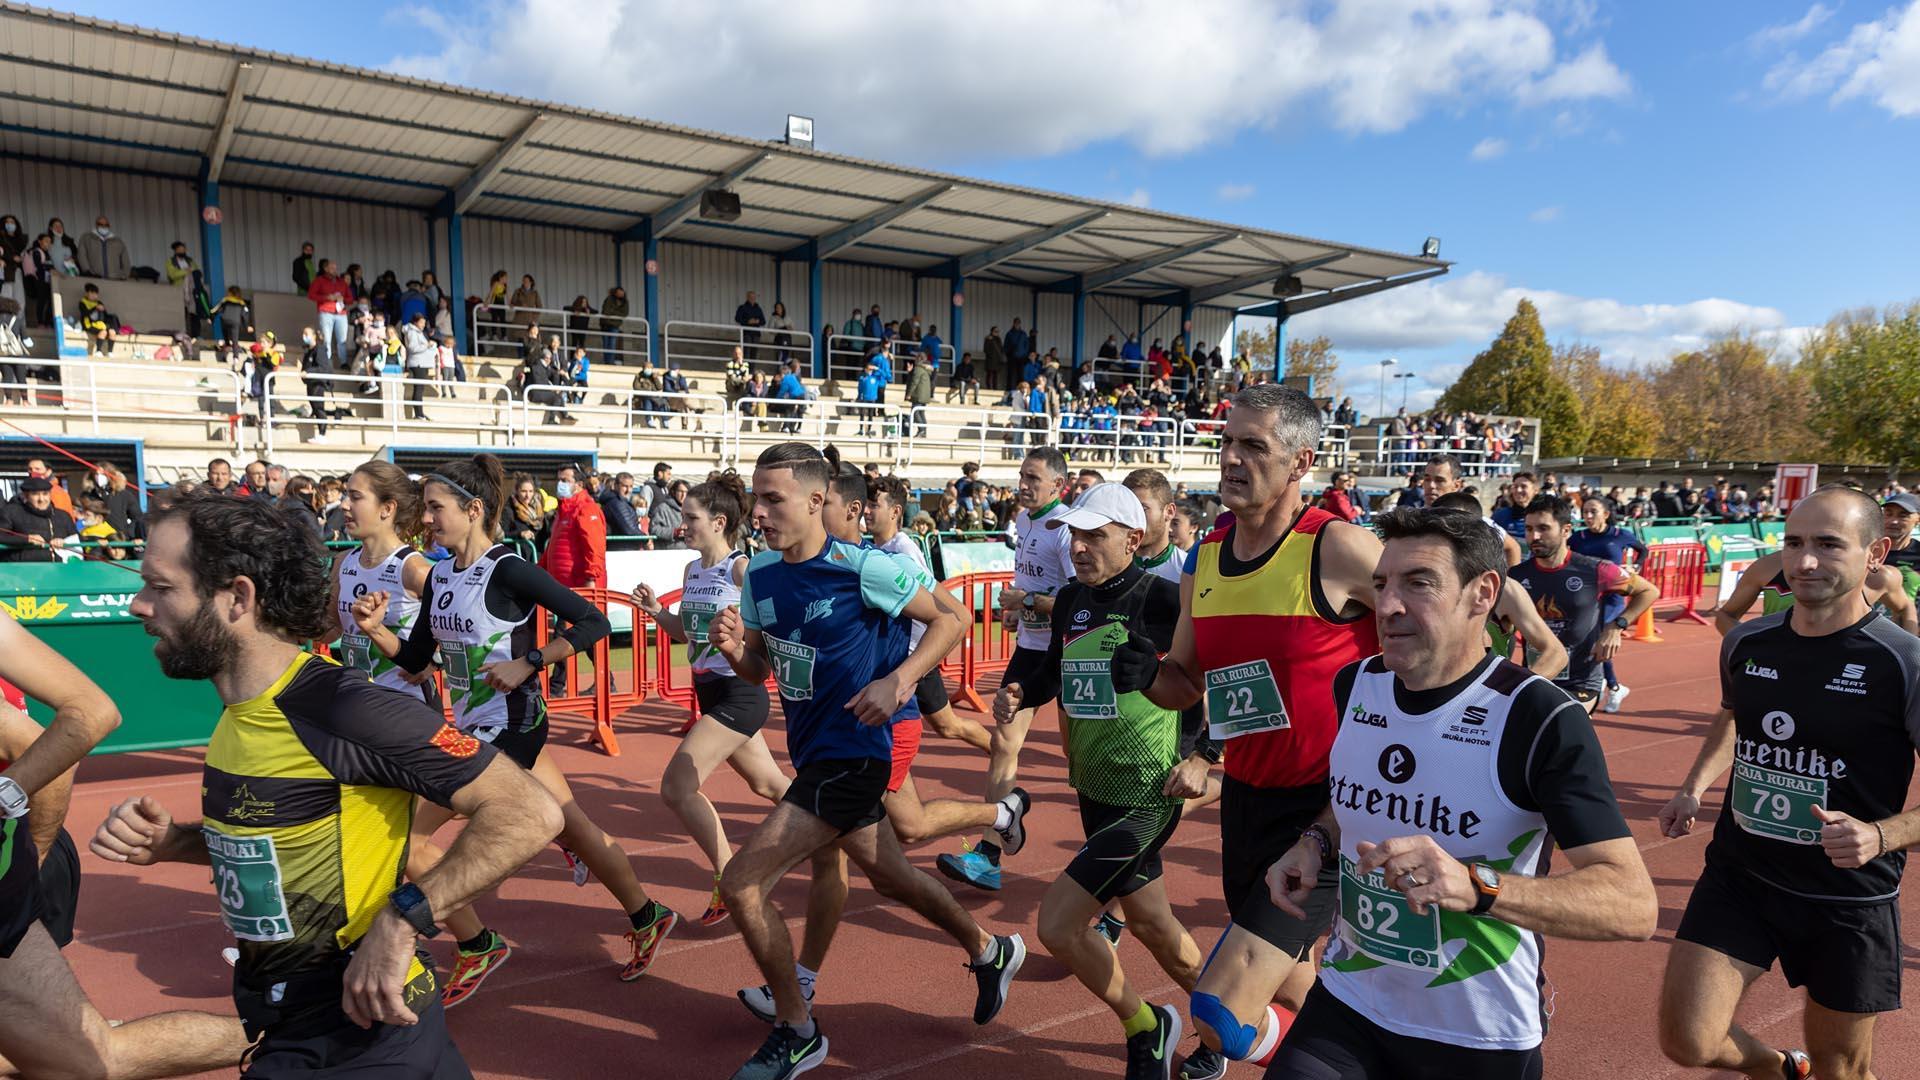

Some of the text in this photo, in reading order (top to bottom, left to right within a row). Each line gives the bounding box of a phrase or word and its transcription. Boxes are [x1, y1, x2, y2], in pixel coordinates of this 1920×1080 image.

[691, 614, 698, 630] 8
[348, 648, 354, 667] 6
[778, 642, 810, 658] RURAL
[444, 654, 452, 673] 7
[773, 655, 791, 682] 91
[1079, 662, 1109, 672] RURAL
[1228, 665, 1264, 681] RURAL
[1745, 664, 1779, 680] LUGA
[1072, 678, 1096, 700] 24
[1832, 678, 1866, 687] SEAT
[1844, 687, 1867, 695] MOTOR
[1225, 687, 1259, 717] 22
[1352, 711, 1388, 729] LUGA
[1441, 732, 1491, 747] IRUÑA MOTOR
[1450, 724, 1489, 736] SEAT
[1735, 733, 1848, 779] txenike
[1738, 764, 1817, 793] CAJA RURAL
[1751, 787, 1791, 821] 79
[222, 839, 264, 858] URAL
[218, 864, 245, 909] 23
[1357, 893, 1400, 939] 82
